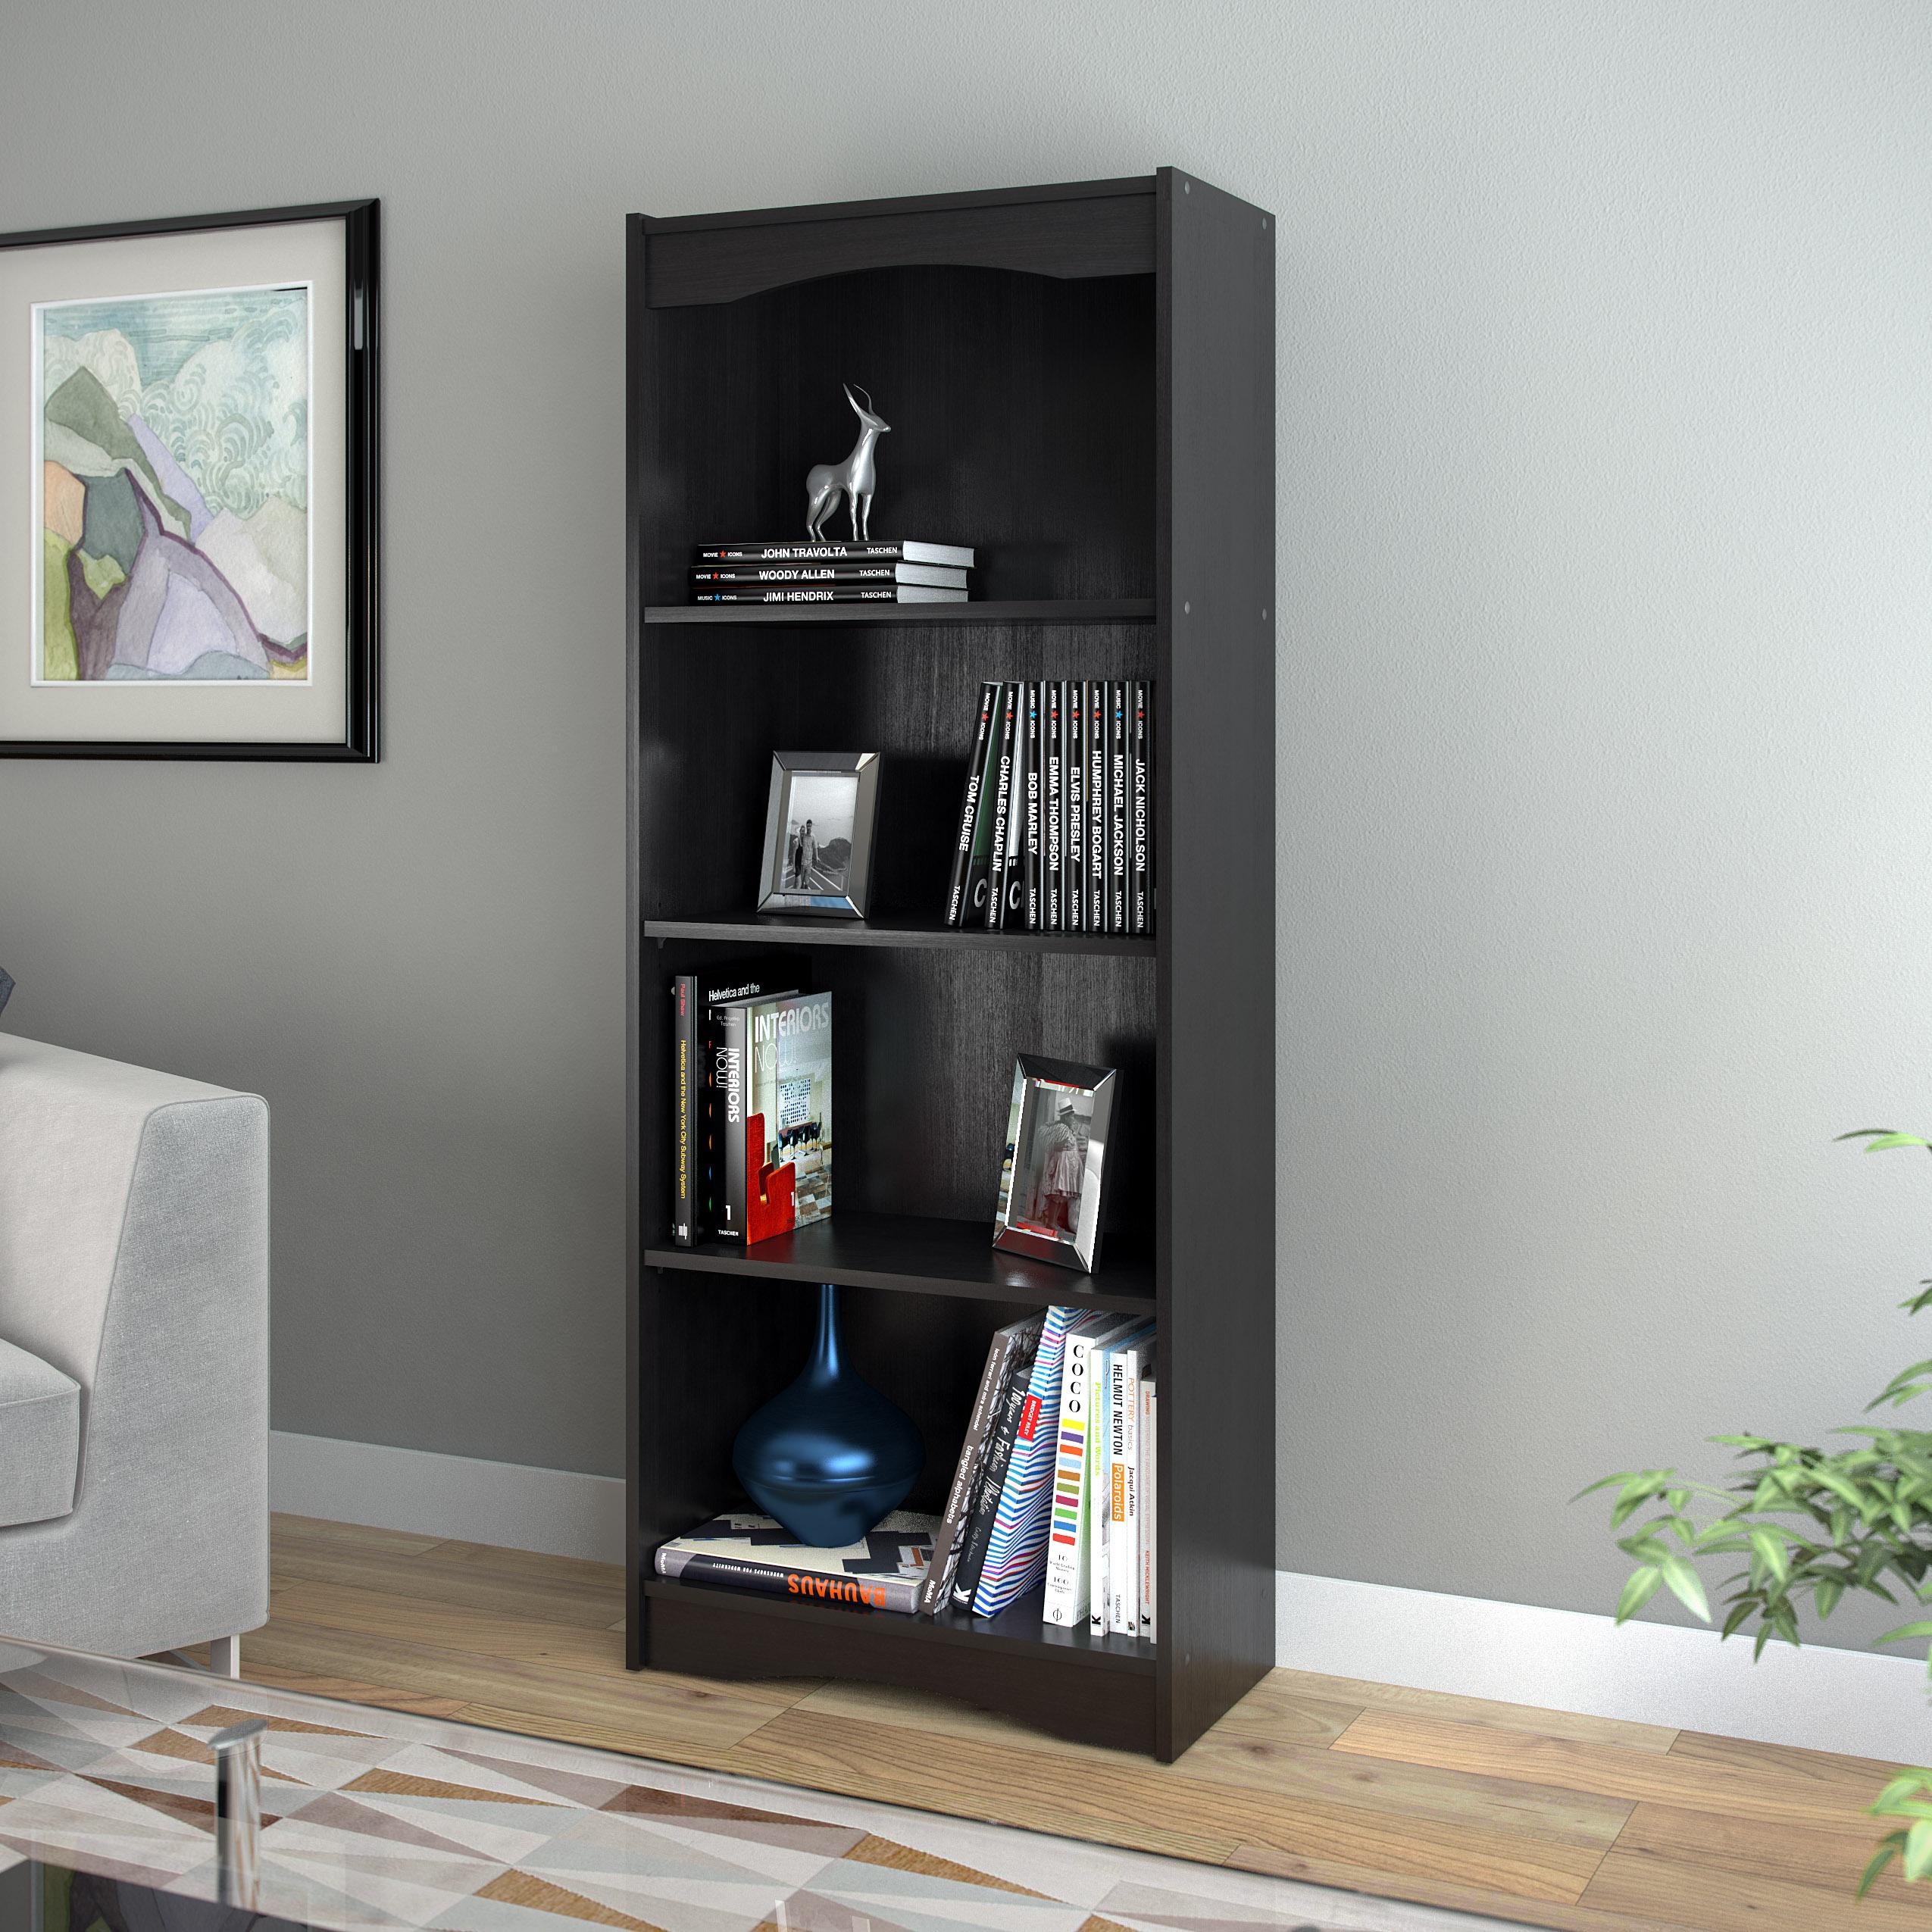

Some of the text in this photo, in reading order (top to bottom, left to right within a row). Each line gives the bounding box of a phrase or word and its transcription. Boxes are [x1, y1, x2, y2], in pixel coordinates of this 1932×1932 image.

[761, 547, 848, 558] JOHN TRAVOLTA
[758, 570, 835, 580] WOODY ALLEN
[763, 592, 834, 602] JIMI HENDRIX
[959, 775, 980, 852] TOM CRUISE
[992, 756, 1010, 872] CHARLES CHAPLIN
[1028, 773, 1037, 855] BOB MARLEY
[1049, 757, 1058, 871] EMMA THOMPSON
[1071, 767, 1080, 862] ELVIS PRESLEY
[1092, 751, 1102, 879] HUMPHREY BOGART
[1114, 755, 1124, 875] MICHAEL JACKSON
[1136, 758, 1145, 871] JACK NICHOLSON
[949, 885, 961, 921] TASCHEN
[989, 887, 999, 923] TASCHEN
[708, 983, 760, 1002] Helvetica and the
[755, 1002, 829, 1043] INTERIORS
[727, 1048, 740, 1123] INTERIORS
[725, 1205, 731, 1221] 1
[988, 1361, 996, 1380] ferrari
[974, 1405, 983, 1431] schendel
[1028, 1400, 1036, 1421] BRIDGET
[1113, 1364, 1123, 1455] HELMUT NEWTON
[989, 1436, 1011, 1472] Fashion
[946, 1445, 974, 1524] tangled alphabets
[979, 1476, 1002, 1515] Illustration
[1113, 1465, 1123, 1521] Polaroids
[712, 1562, 741, 1571] MODERNITY
[754, 1568, 784, 1578] WORKSHOPS
[787, 1574, 886, 1608] BAUHAUS
[924, 1580, 936, 1603] MoMA
